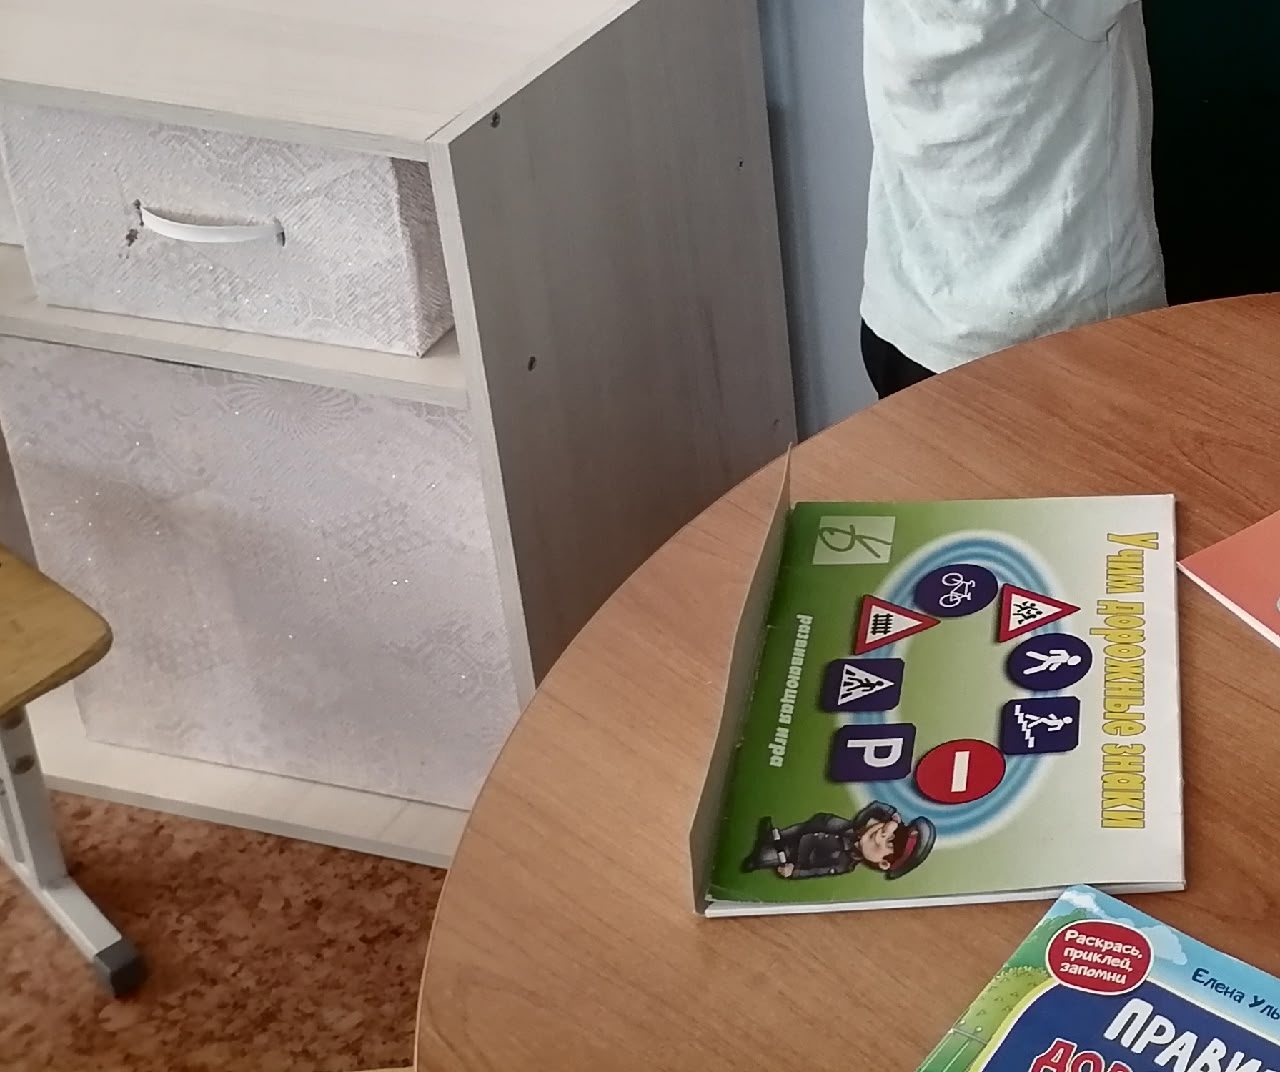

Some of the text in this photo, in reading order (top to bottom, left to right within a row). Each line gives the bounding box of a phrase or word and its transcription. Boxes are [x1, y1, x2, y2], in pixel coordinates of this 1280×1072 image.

[768, 614, 813, 768] развивающая игра
[1089, 531, 1160, 829] Учим дорожные знаки
[1062, 945, 1134, 973] приклей,
[1064, 929, 1143, 960] Раскрась,
[1060, 961, 1128, 986] запомни
[1191, 967, 1245, 1004] Елена
[1103, 997, 1274, 1072] ПРАВ
